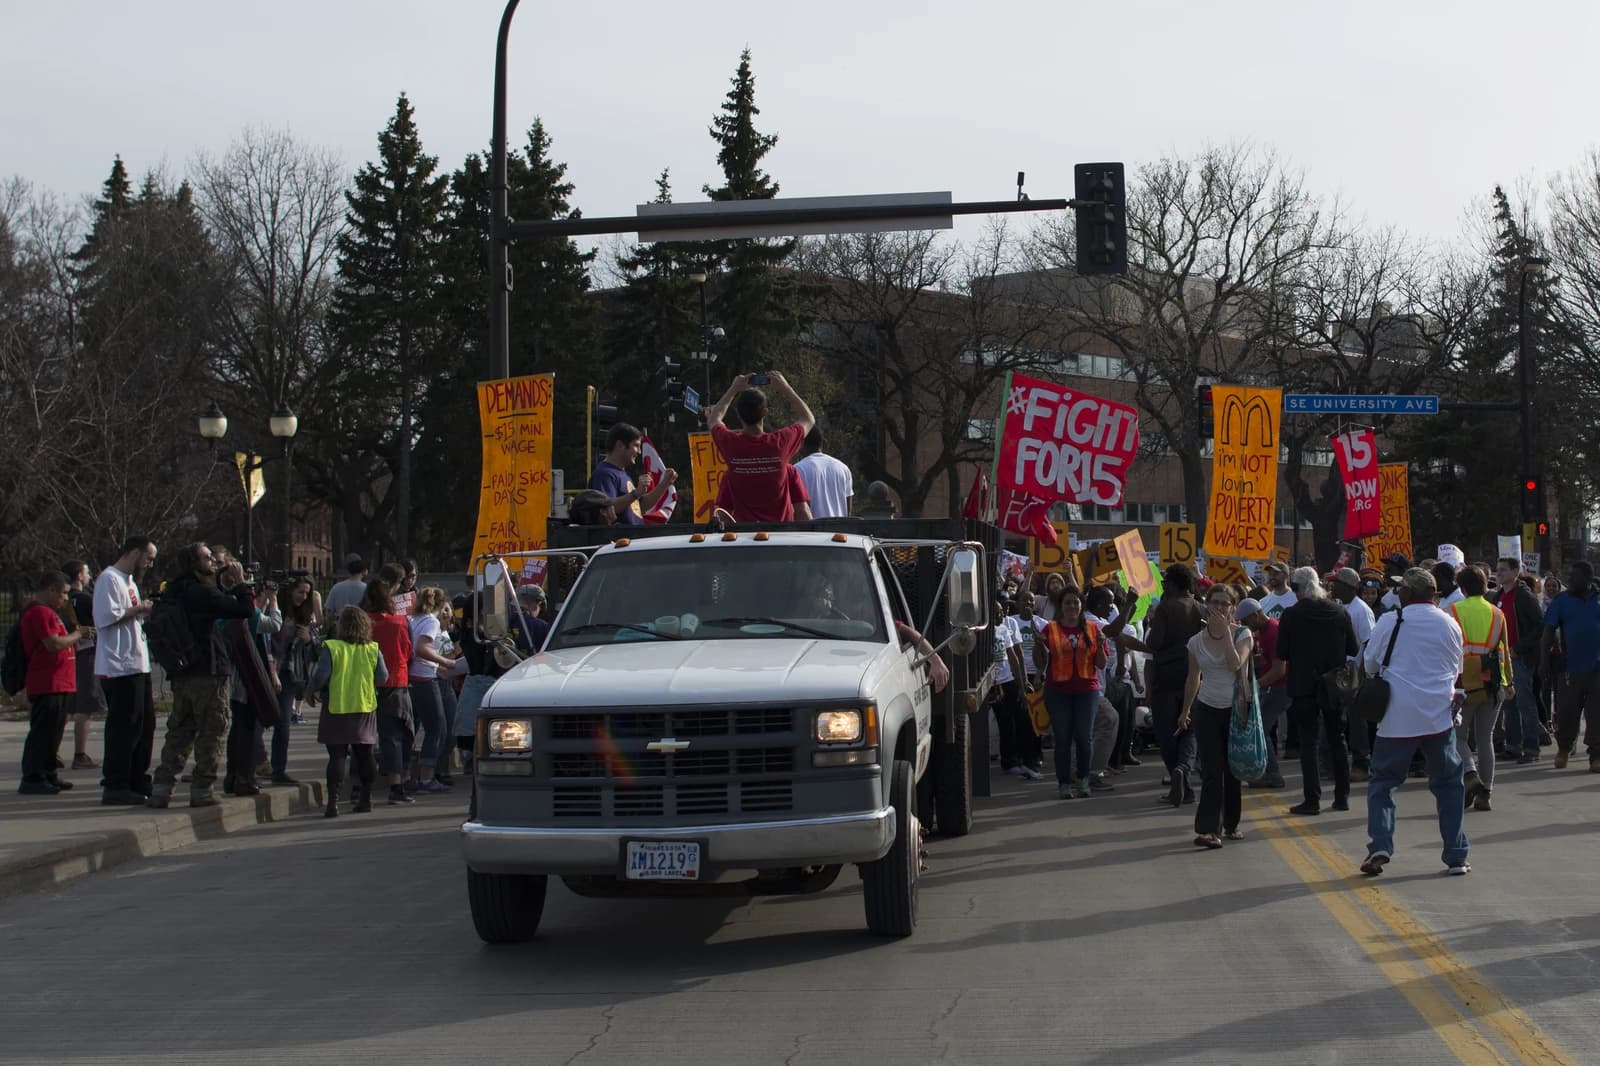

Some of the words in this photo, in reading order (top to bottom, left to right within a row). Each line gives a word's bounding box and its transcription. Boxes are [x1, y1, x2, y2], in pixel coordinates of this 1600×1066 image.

[485, 379, 552, 414] DEMANDS:
[1289, 398, 1306, 409] SE
[1313, 398, 1398, 410] UNIVERSITY
[1405, 399, 1433, 410] AVE
[501, 439, 537, 455] WAGE
[1336, 429, 1372, 473] 15
[1241, 454, 1273, 475] NOT
[493, 488, 528, 506] DAYS
[1344, 477, 1377, 501] NOW
[1214, 493, 1273, 524] POVERTY
[489, 520, 520, 539] FAIR
[1213, 522, 1269, 552] WAGES
[1163, 527, 1193, 563] 15
[1119, 535, 1154, 591] 15
